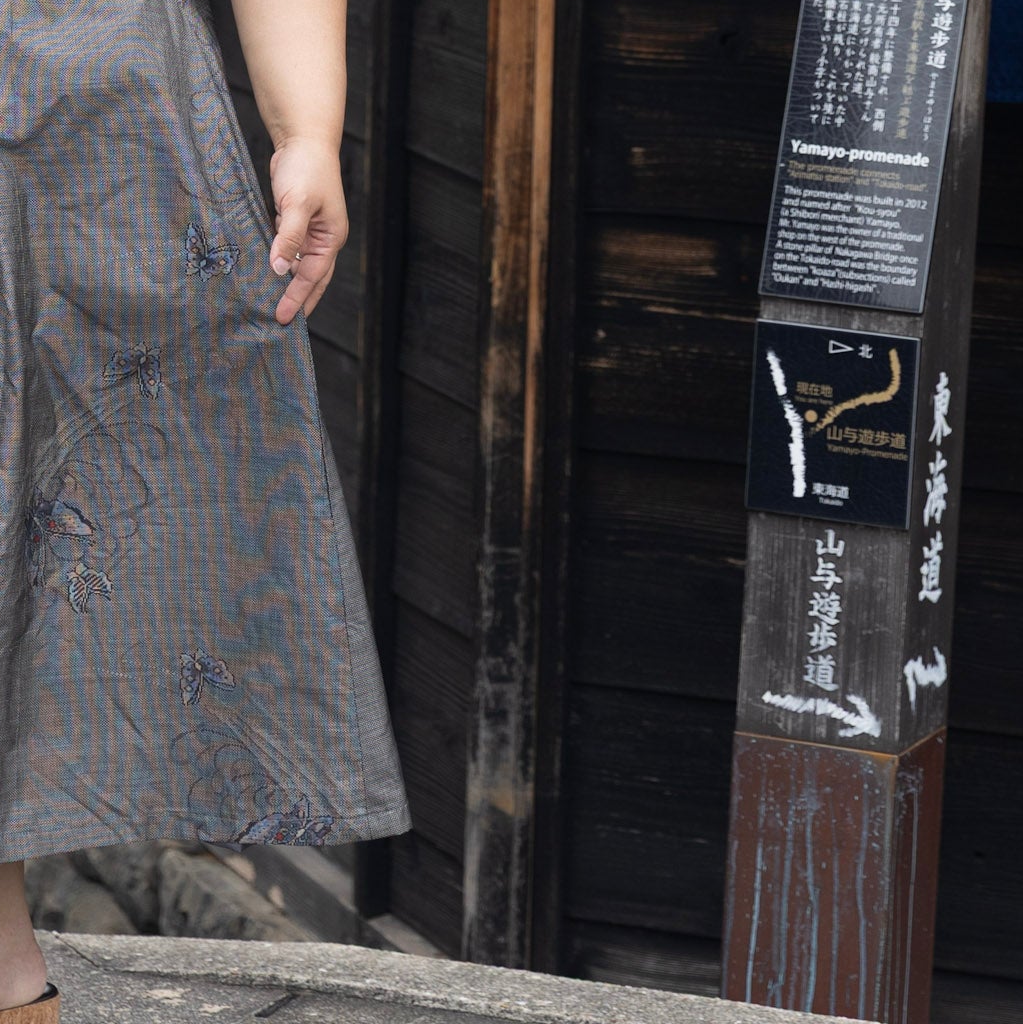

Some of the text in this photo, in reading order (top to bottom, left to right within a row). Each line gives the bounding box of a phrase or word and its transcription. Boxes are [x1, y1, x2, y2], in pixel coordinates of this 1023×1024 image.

[791, 140, 929, 167] Yamayo-promenade
[782, 197, 799, 205] and
[800, 199, 830, 209] named
[832, 202, 851, 211] after
[785, 186, 927, 209] This promenade was built in 2012
[790, 209, 819, 219] Shibori
[777, 229, 796, 239] shop
[808, 233, 820, 241] the
[822, 235, 838, 243] west
[840, 236, 847, 244] of
[848, 237, 860, 245] the
[791, 220, 820, 231] Yamayo
[836, 225, 848, 233] the
[873, 229, 880, 237] of
[887, 230, 923, 241] traditional
[783, 242, 804, 250] stone
[805, 243, 824, 253] pillar
[825, 245, 833, 253] of
[835, 247, 873, 259] Nakagawa
[874, 251, 898, 262] Bridge
[773, 262, 809, 273] between
[892, 276, 916, 285] called
[786, 252, 799, 261] the
[866, 262, 879, 270] the
[881, 263, 917, 275] boundary
[804, 277, 819, 285] and
[858, 343, 873, 358] 北
[796, 381, 833, 397] 現在地
[827, 425, 906, 450] 山与遊歩道
[827, 444, 908, 461] Yamayo-Promenade
[812, 482, 850, 499] 東海道
[918, 371, 952, 604] 東海道
[803, 529, 845, 692] 山与遊歩道
